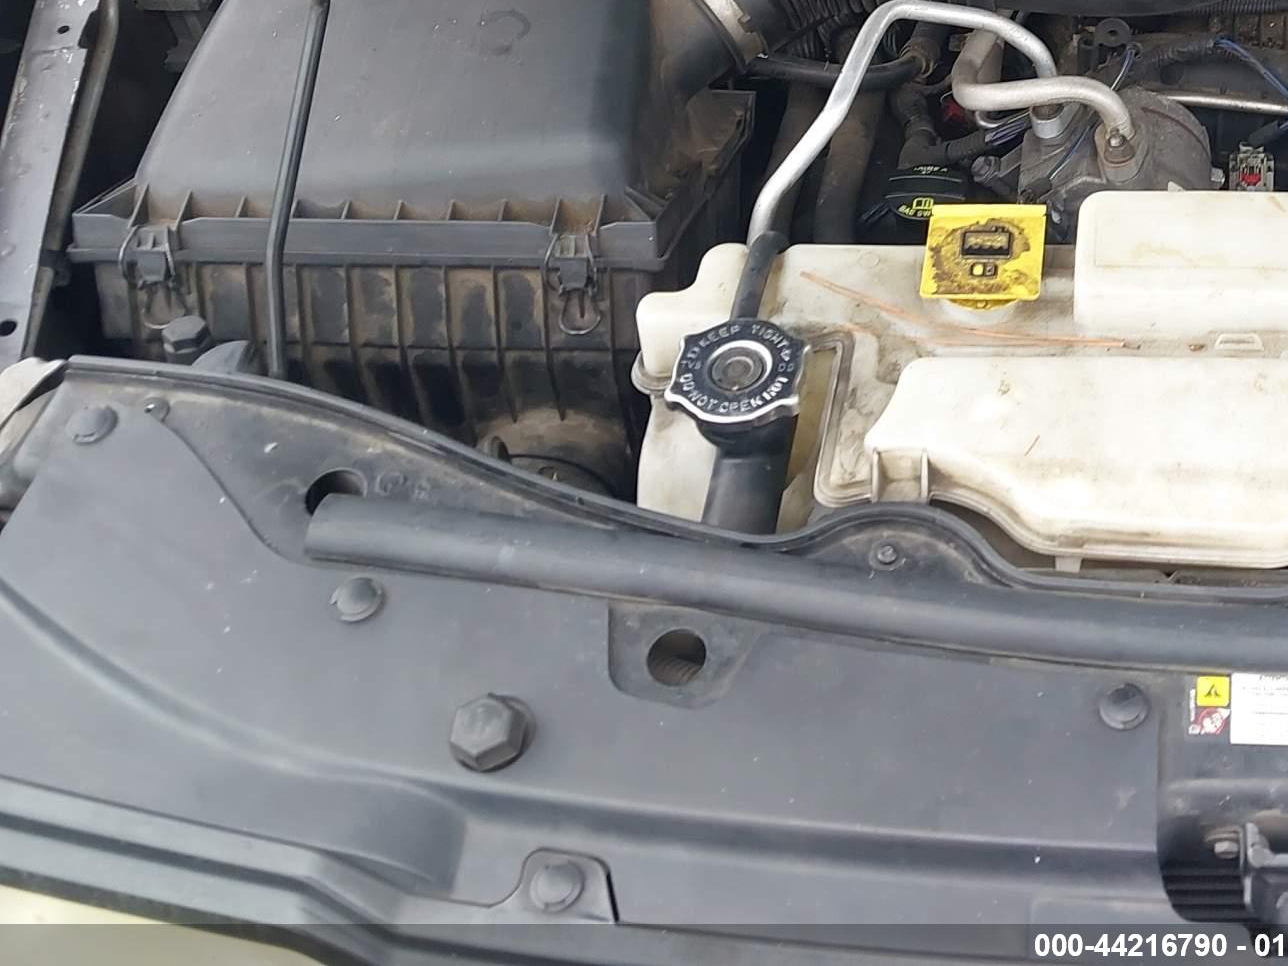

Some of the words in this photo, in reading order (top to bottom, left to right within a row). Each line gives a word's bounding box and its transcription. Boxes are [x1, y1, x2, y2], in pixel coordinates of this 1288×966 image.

[698, 324, 741, 348] KEEP
[750, 323, 792, 349] TIGHT
[679, 373, 696, 392] DO
[687, 389, 719, 411] NOT
